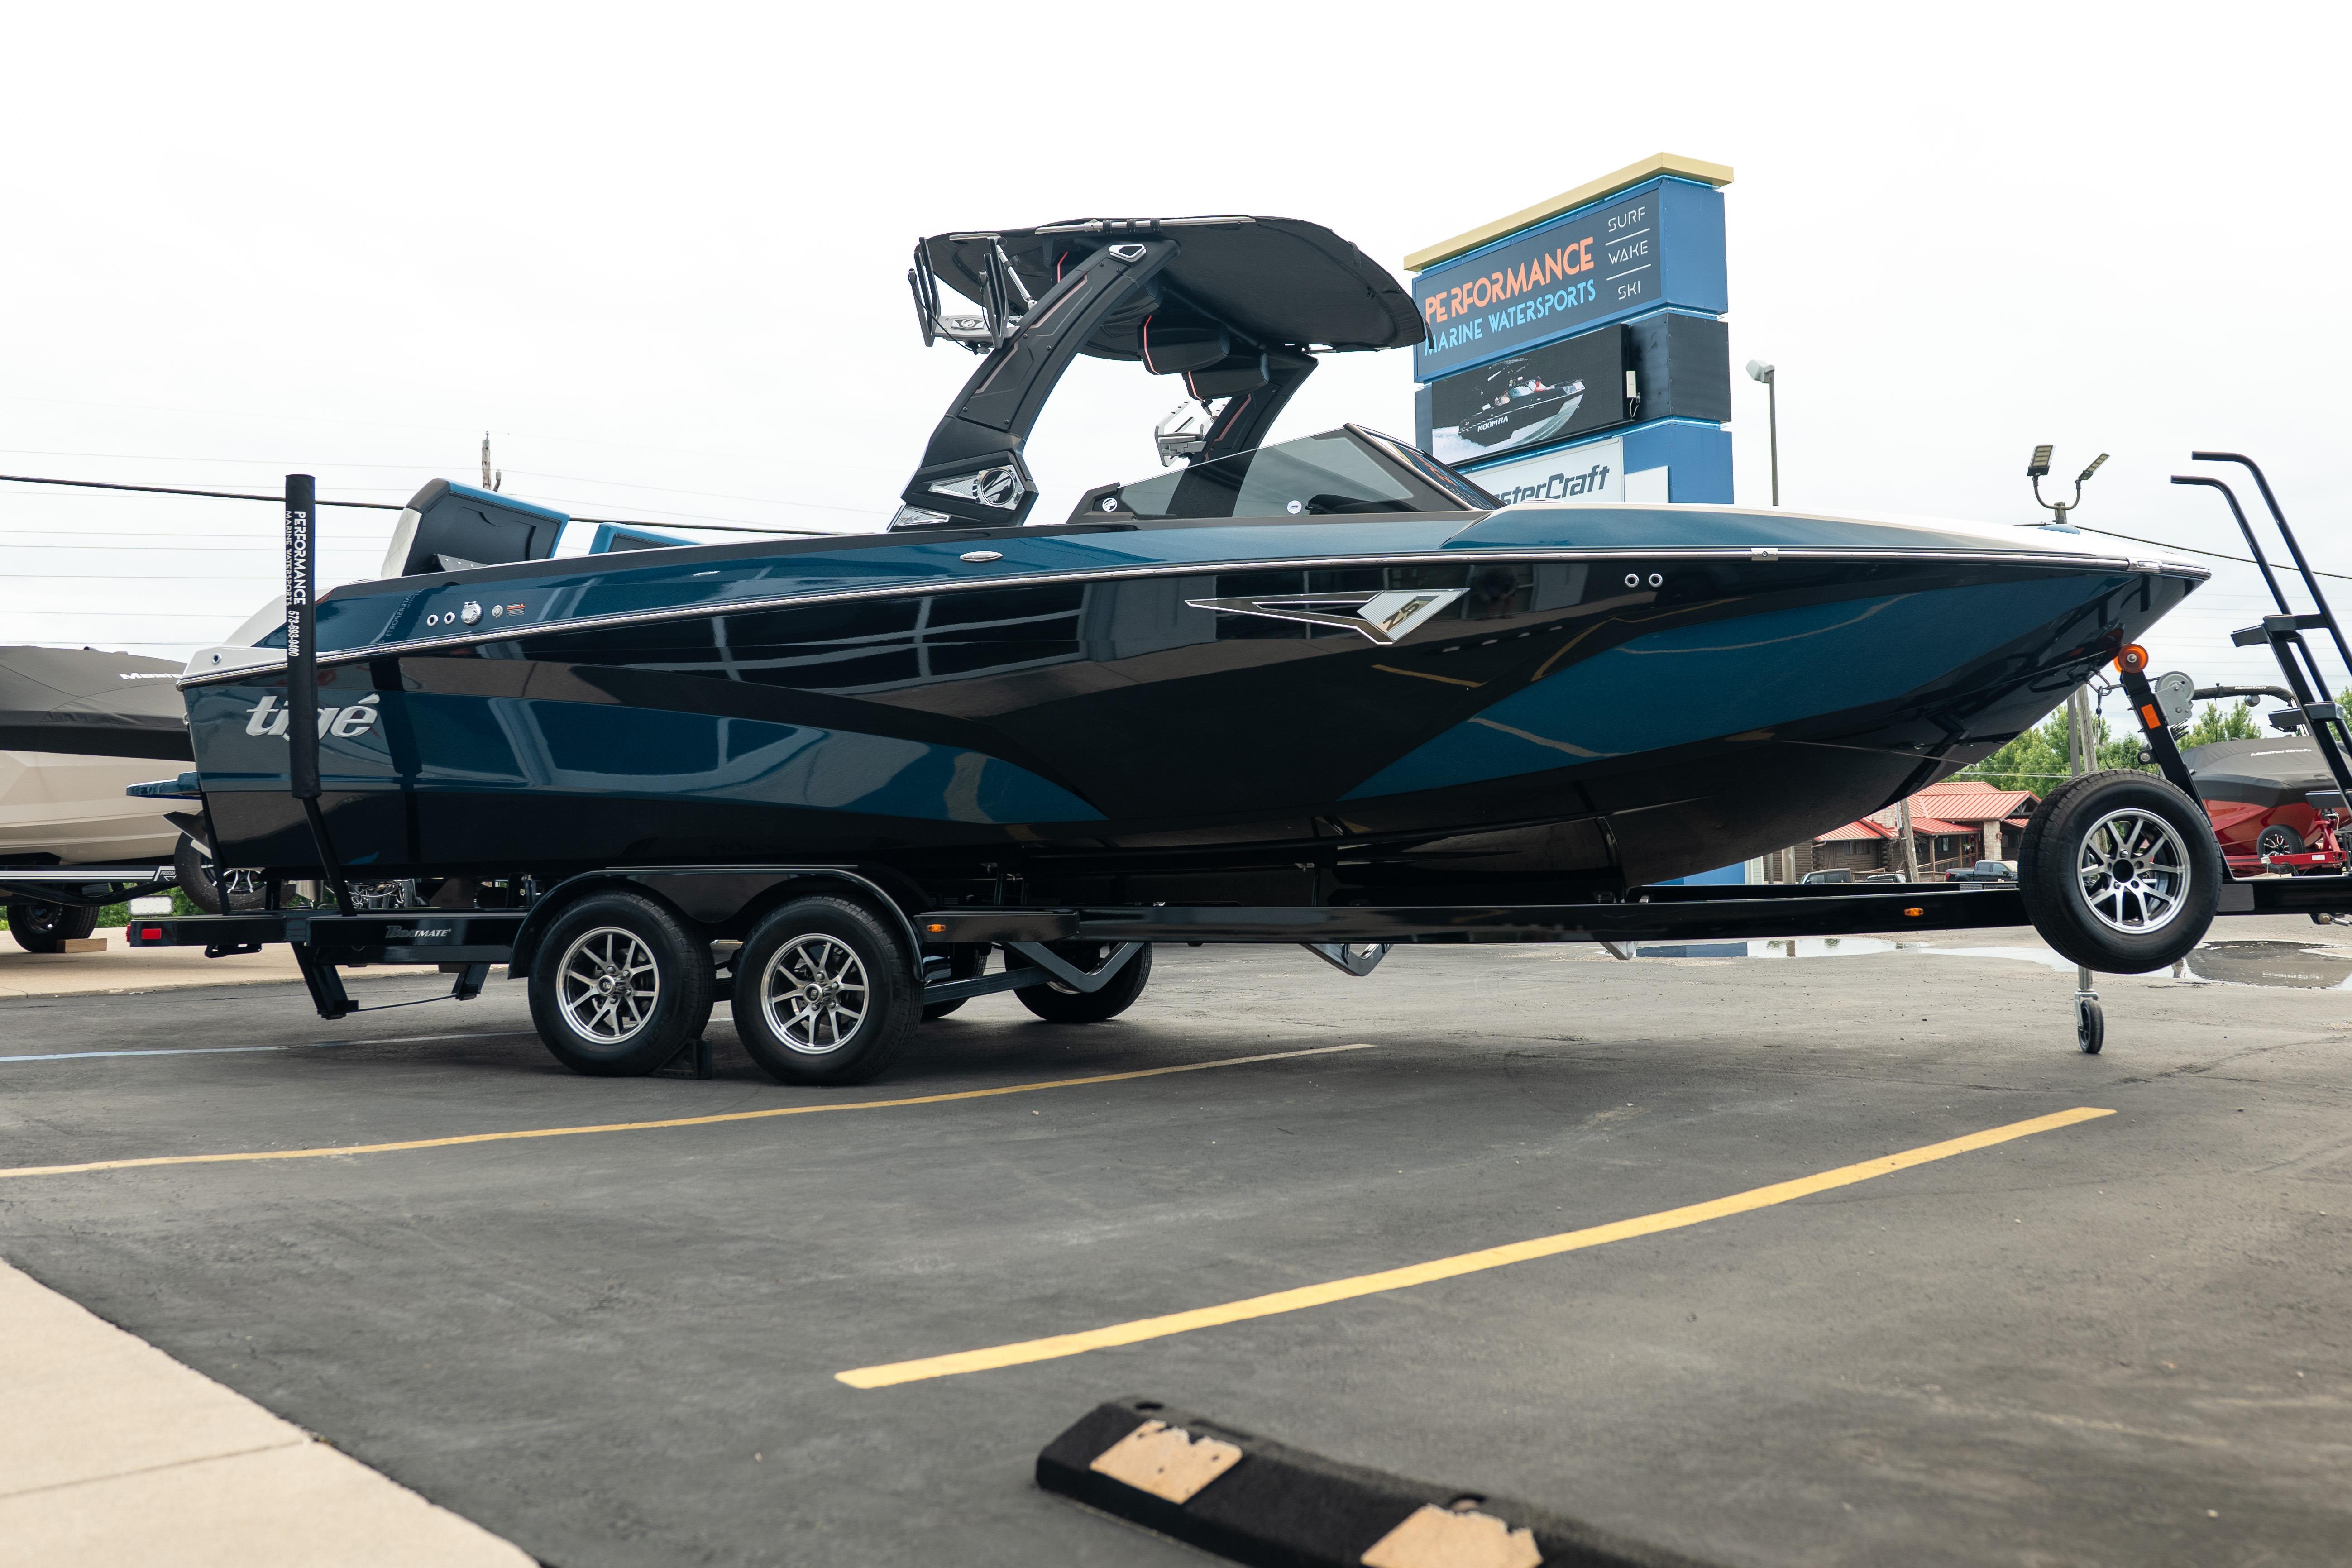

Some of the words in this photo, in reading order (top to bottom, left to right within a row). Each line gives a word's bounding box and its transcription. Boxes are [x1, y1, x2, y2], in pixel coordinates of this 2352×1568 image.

[1608, 206, 1645, 232] SURF
[1608, 240, 1648, 265] WAKE
[1425, 236, 1594, 326] PERFORMANCE
[1618, 280, 1640, 300] SKI
[1488, 279, 1596, 334] WATERSPORTS
[1495, 464, 1610, 504] sterCraft
[293, 511, 306, 605] PERFORMANCE
[1382, 599, 1420, 631] Z5
[288, 610, 300, 657] 573-693-9400
[2250, 748, 2312, 757] MasterCraft
